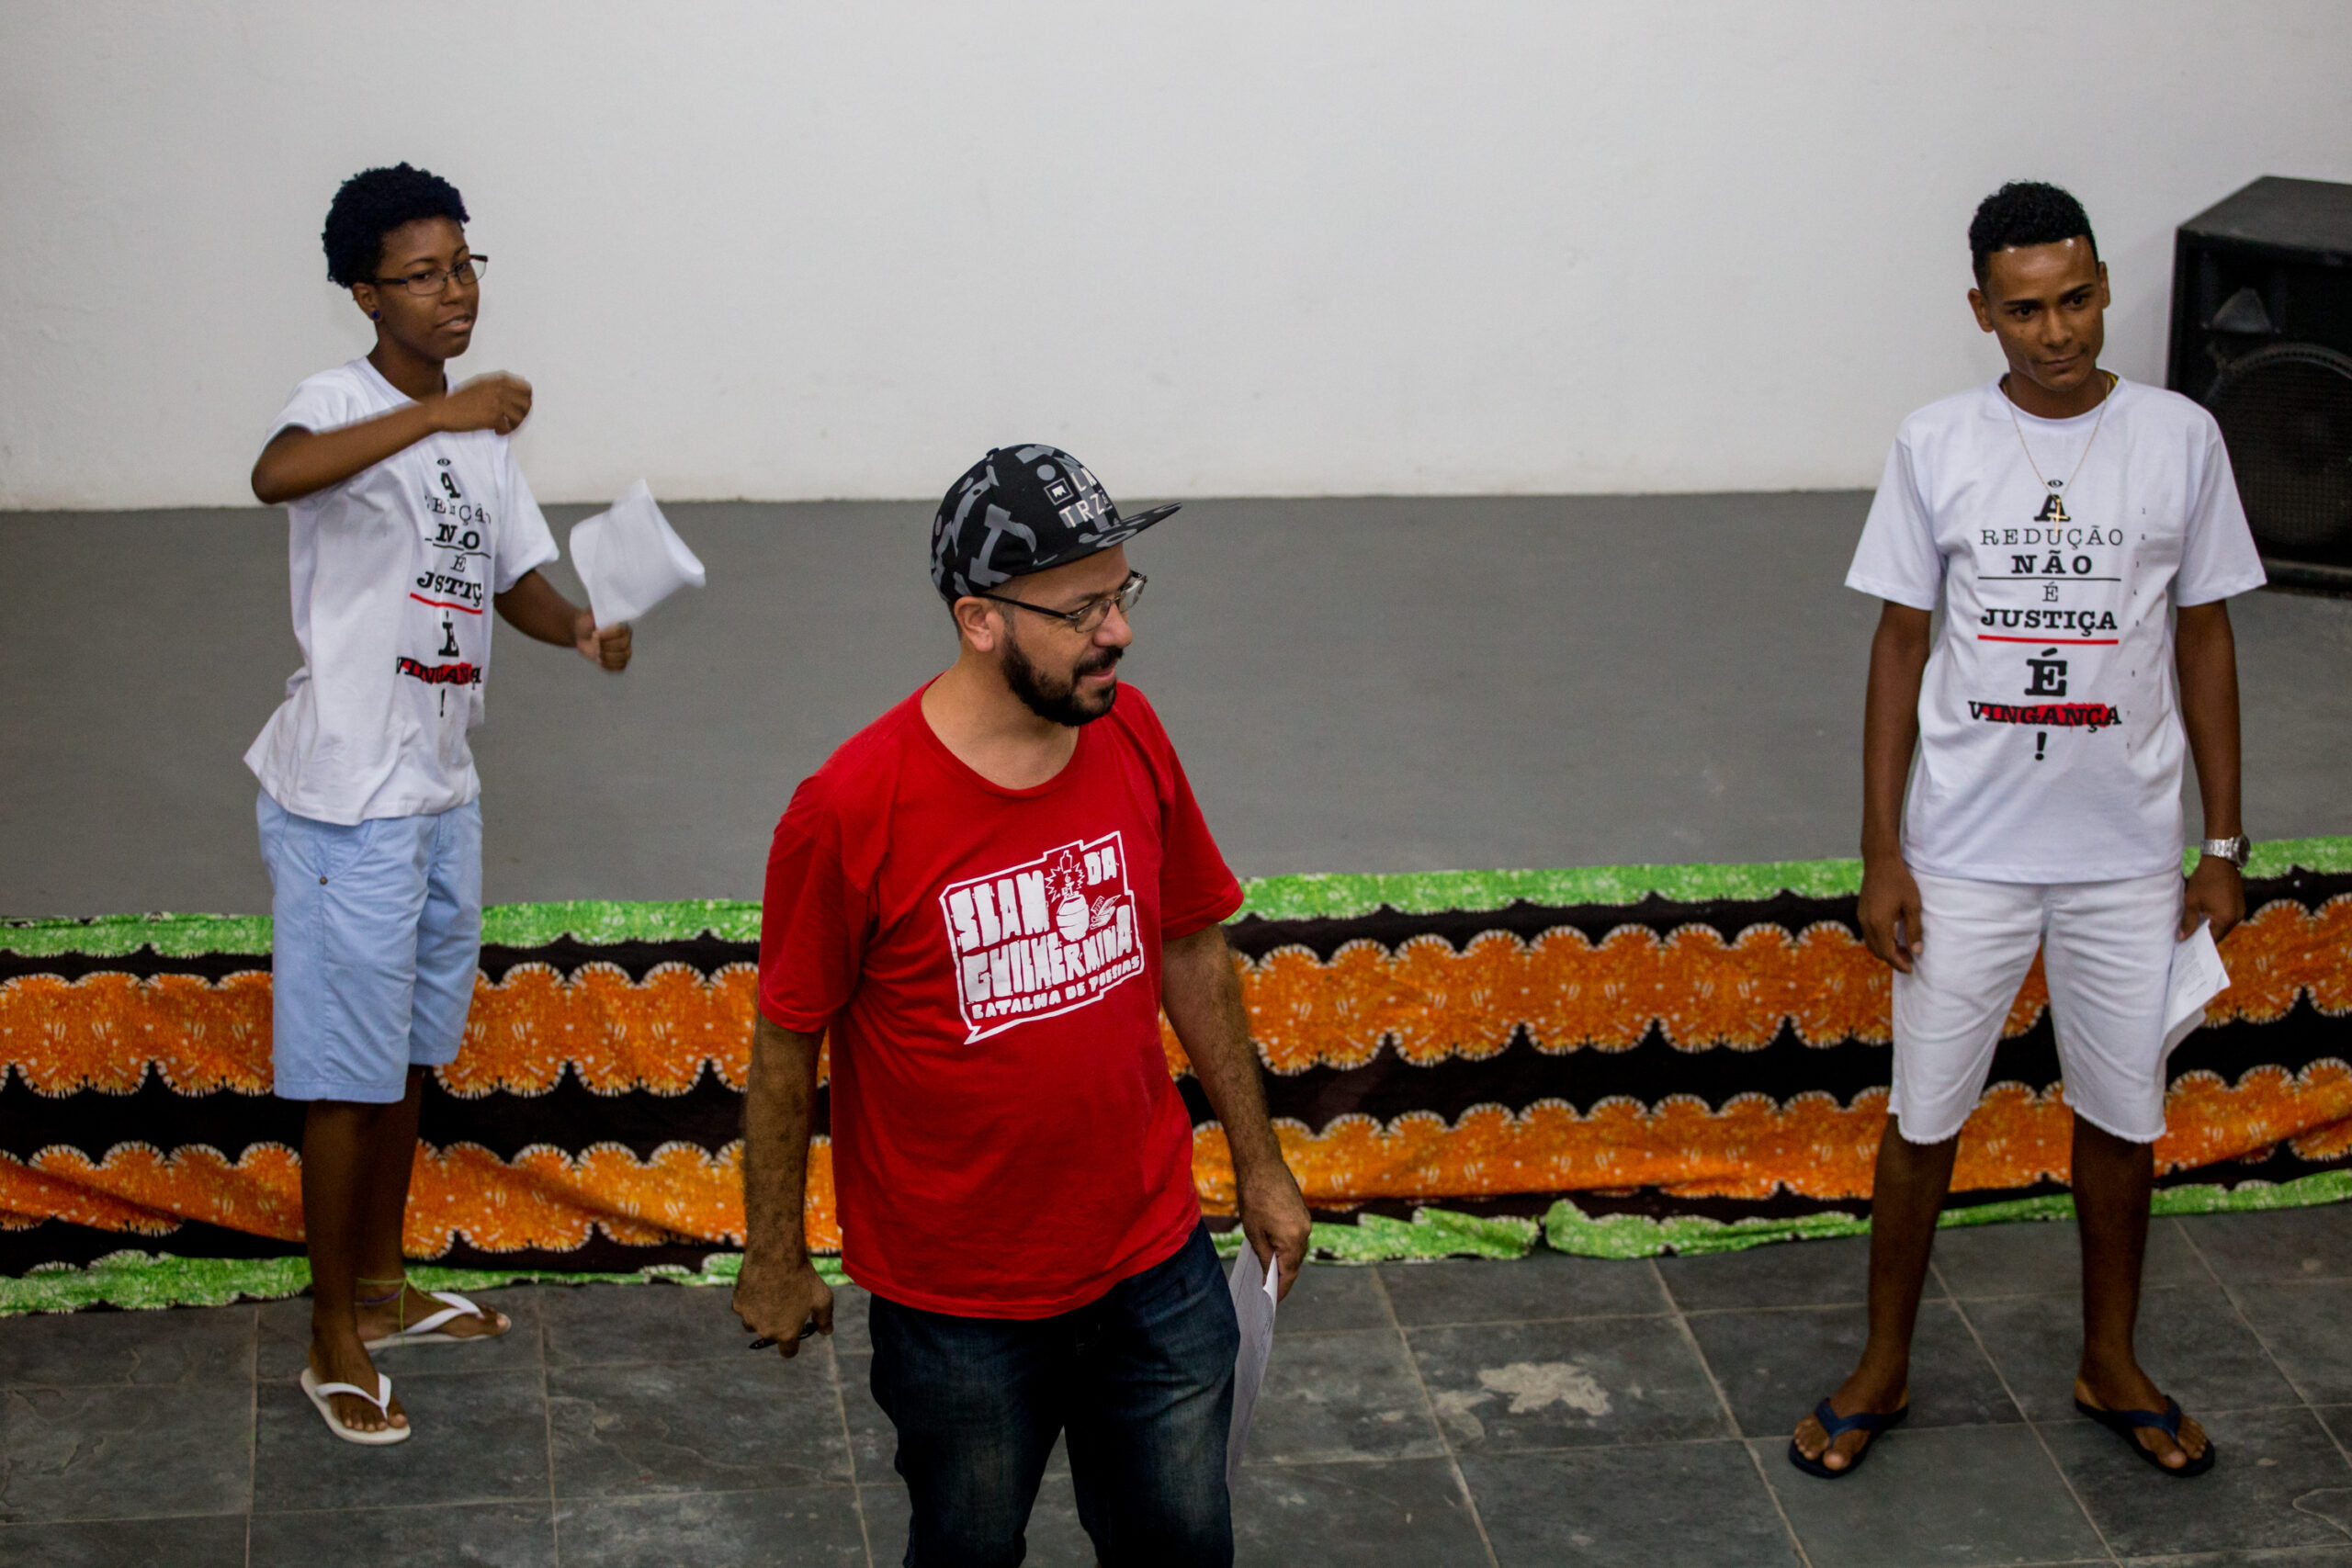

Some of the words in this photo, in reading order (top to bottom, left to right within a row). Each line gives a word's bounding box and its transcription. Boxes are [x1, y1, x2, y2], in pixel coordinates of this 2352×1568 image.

[2033, 493, 2071, 523] A
[435, 523, 481, 550] NO
[1980, 525, 2124, 551] REDUÇÃO
[2010, 549, 2093, 575] NÃO
[2041, 581, 2059, 603] É
[1980, 608, 2118, 637] JUSTIÇA
[2024, 647, 2068, 697] É
[440, 688, 447, 717] !
[1967, 700, 2123, 733] VINGANÇA
[2034, 731, 2048, 761] !
[949, 870, 1050, 953] SLAM
[1083, 845, 1120, 886] DA
[961, 904, 1133, 1005] GUILHERMINA
[972, 989, 1061, 1020] BATALHA
[1065, 982, 1085, 1000] DE
[1089, 955, 1140, 993] POESIAS
